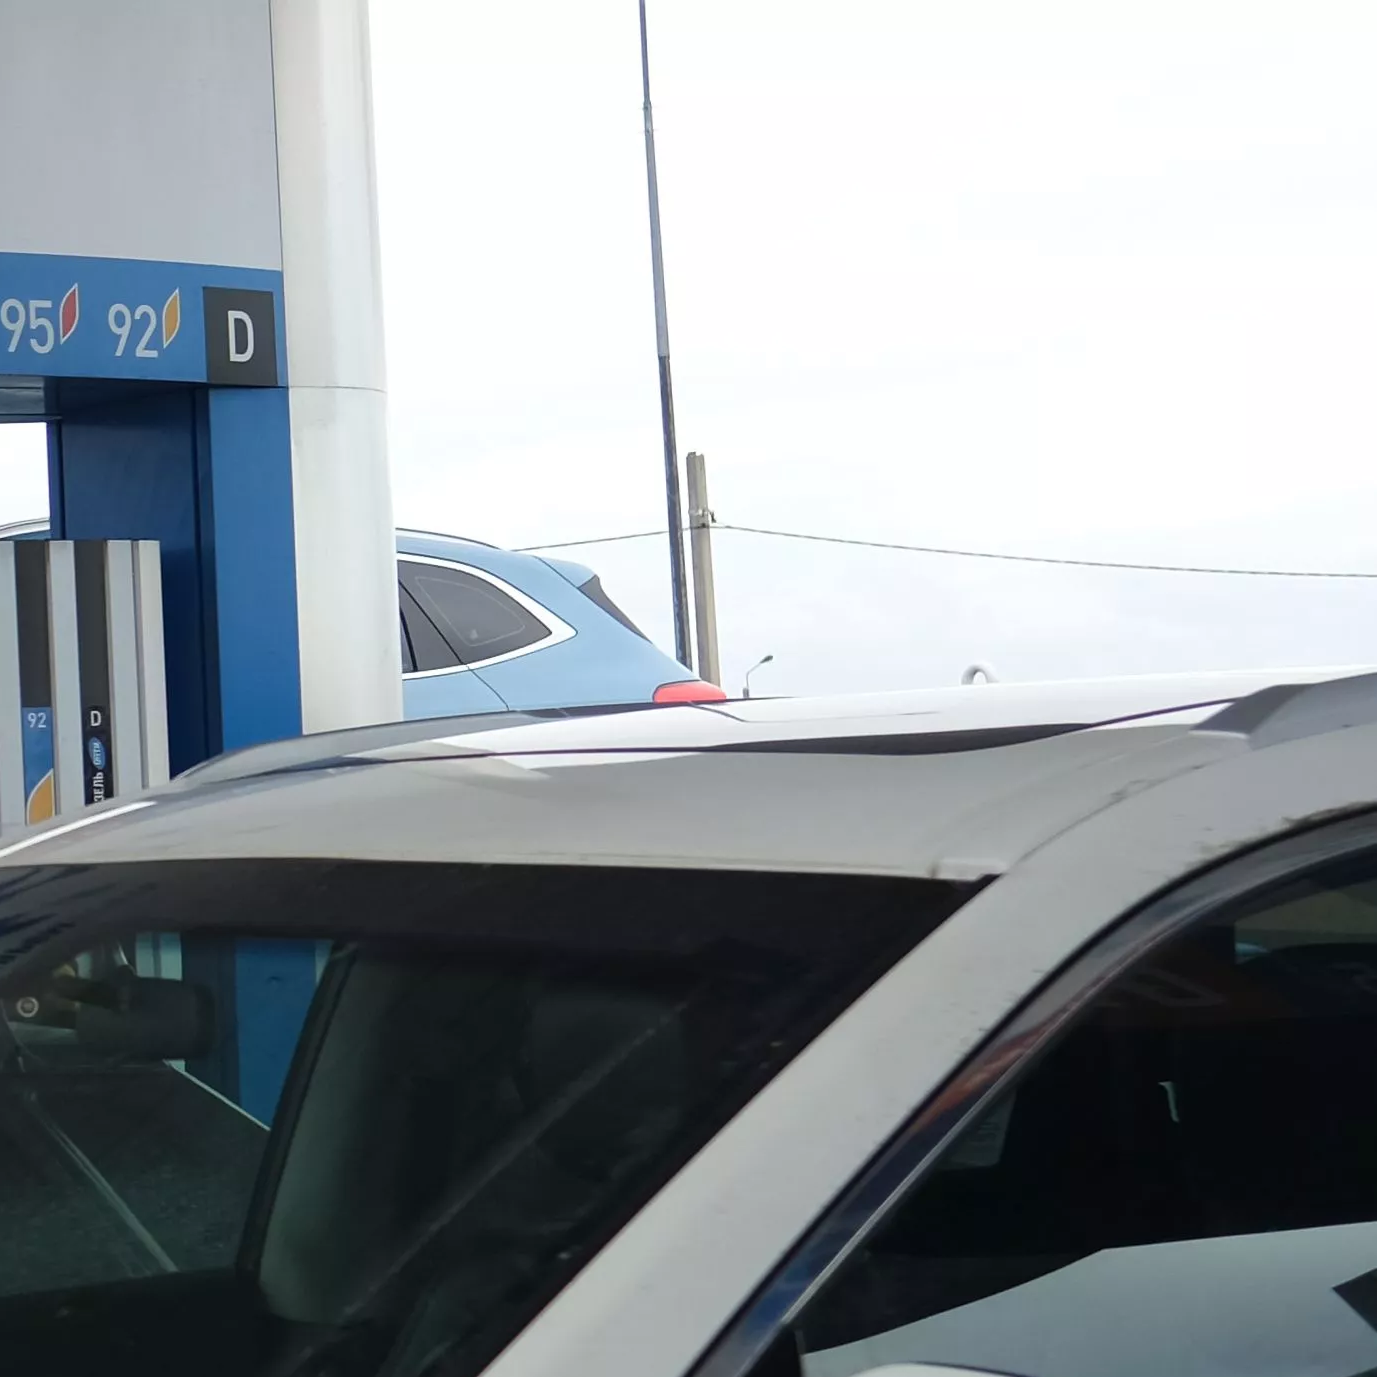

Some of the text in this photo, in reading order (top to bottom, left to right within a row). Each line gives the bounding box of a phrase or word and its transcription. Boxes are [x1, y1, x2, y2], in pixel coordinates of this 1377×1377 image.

[0, 298, 55, 355] 95
[107, 303, 159, 358] 92
[228, 310, 255, 363] D
[27, 712, 46, 728] 92
[90, 710, 102, 727] D
